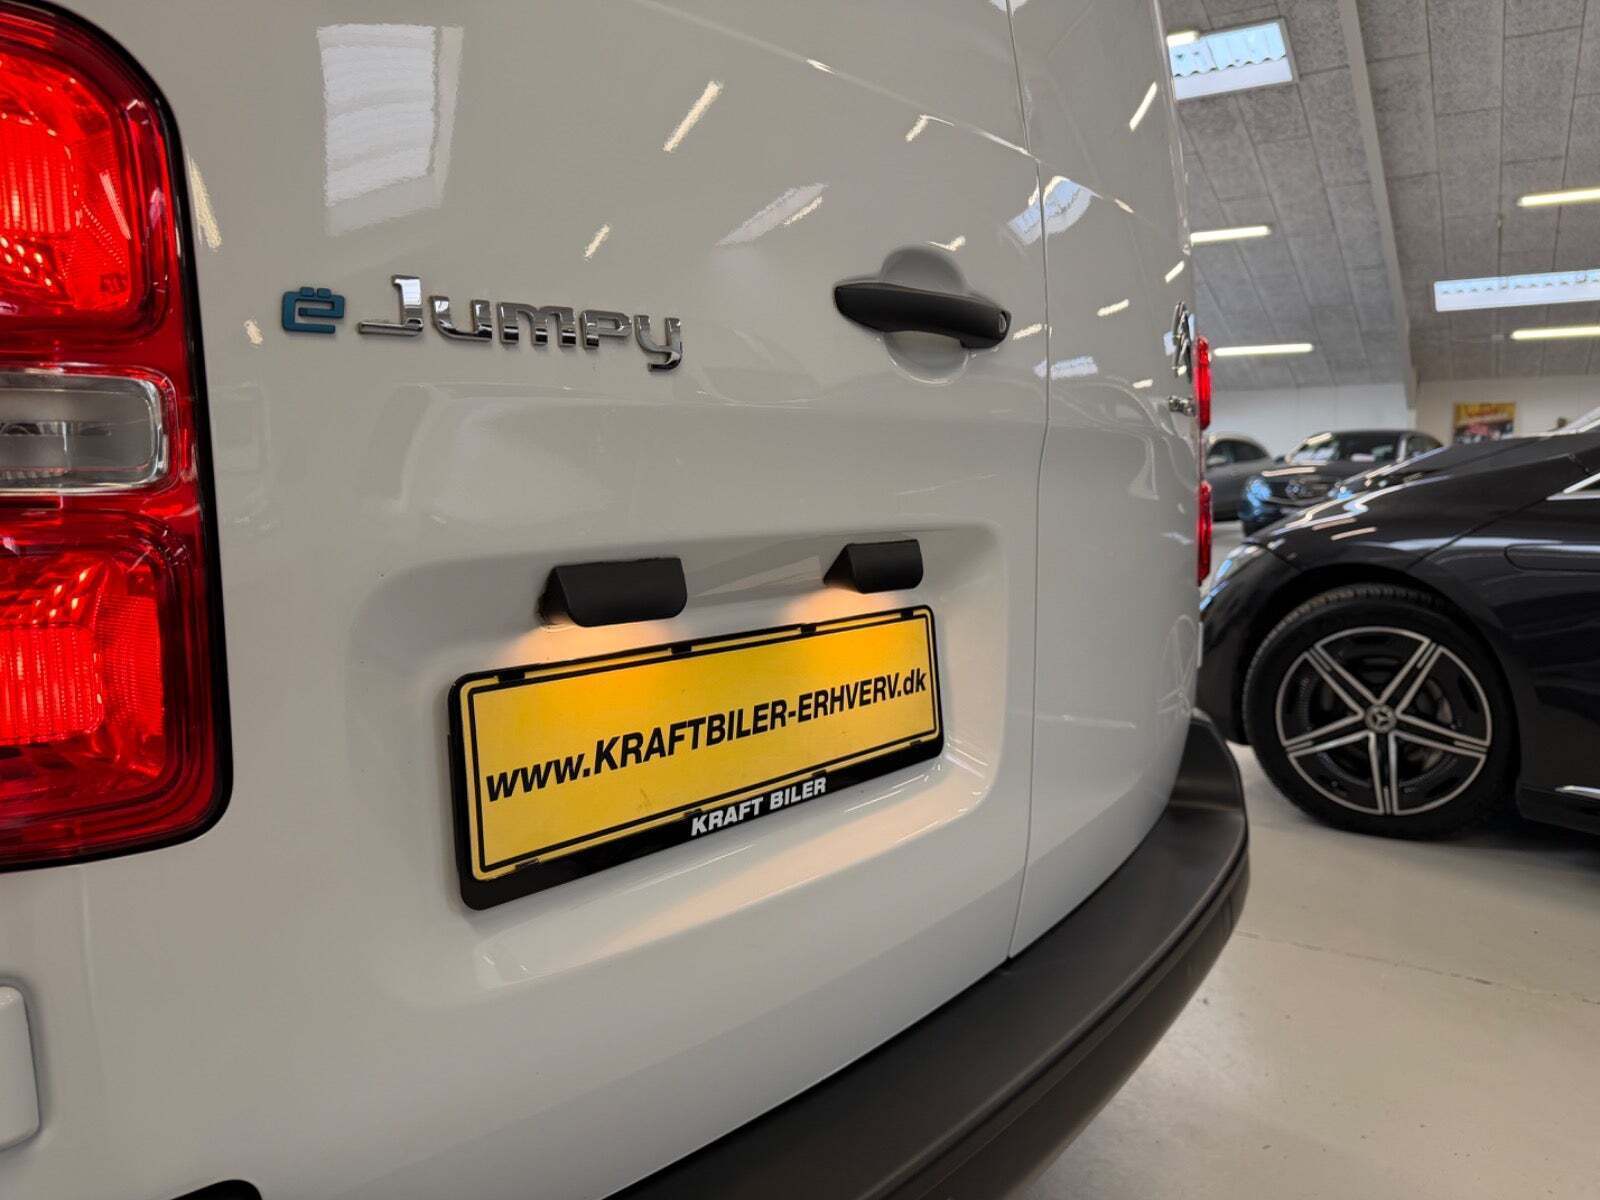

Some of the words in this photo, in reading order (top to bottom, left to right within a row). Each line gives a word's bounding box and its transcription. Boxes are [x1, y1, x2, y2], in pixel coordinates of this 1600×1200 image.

[358, 274, 683, 372] Jumpy
[486, 668, 927, 802] www.KRAFTBILER-ERHVERV.dk
[691, 797, 764, 837] KRAFT
[769, 777, 827, 810] BILER
